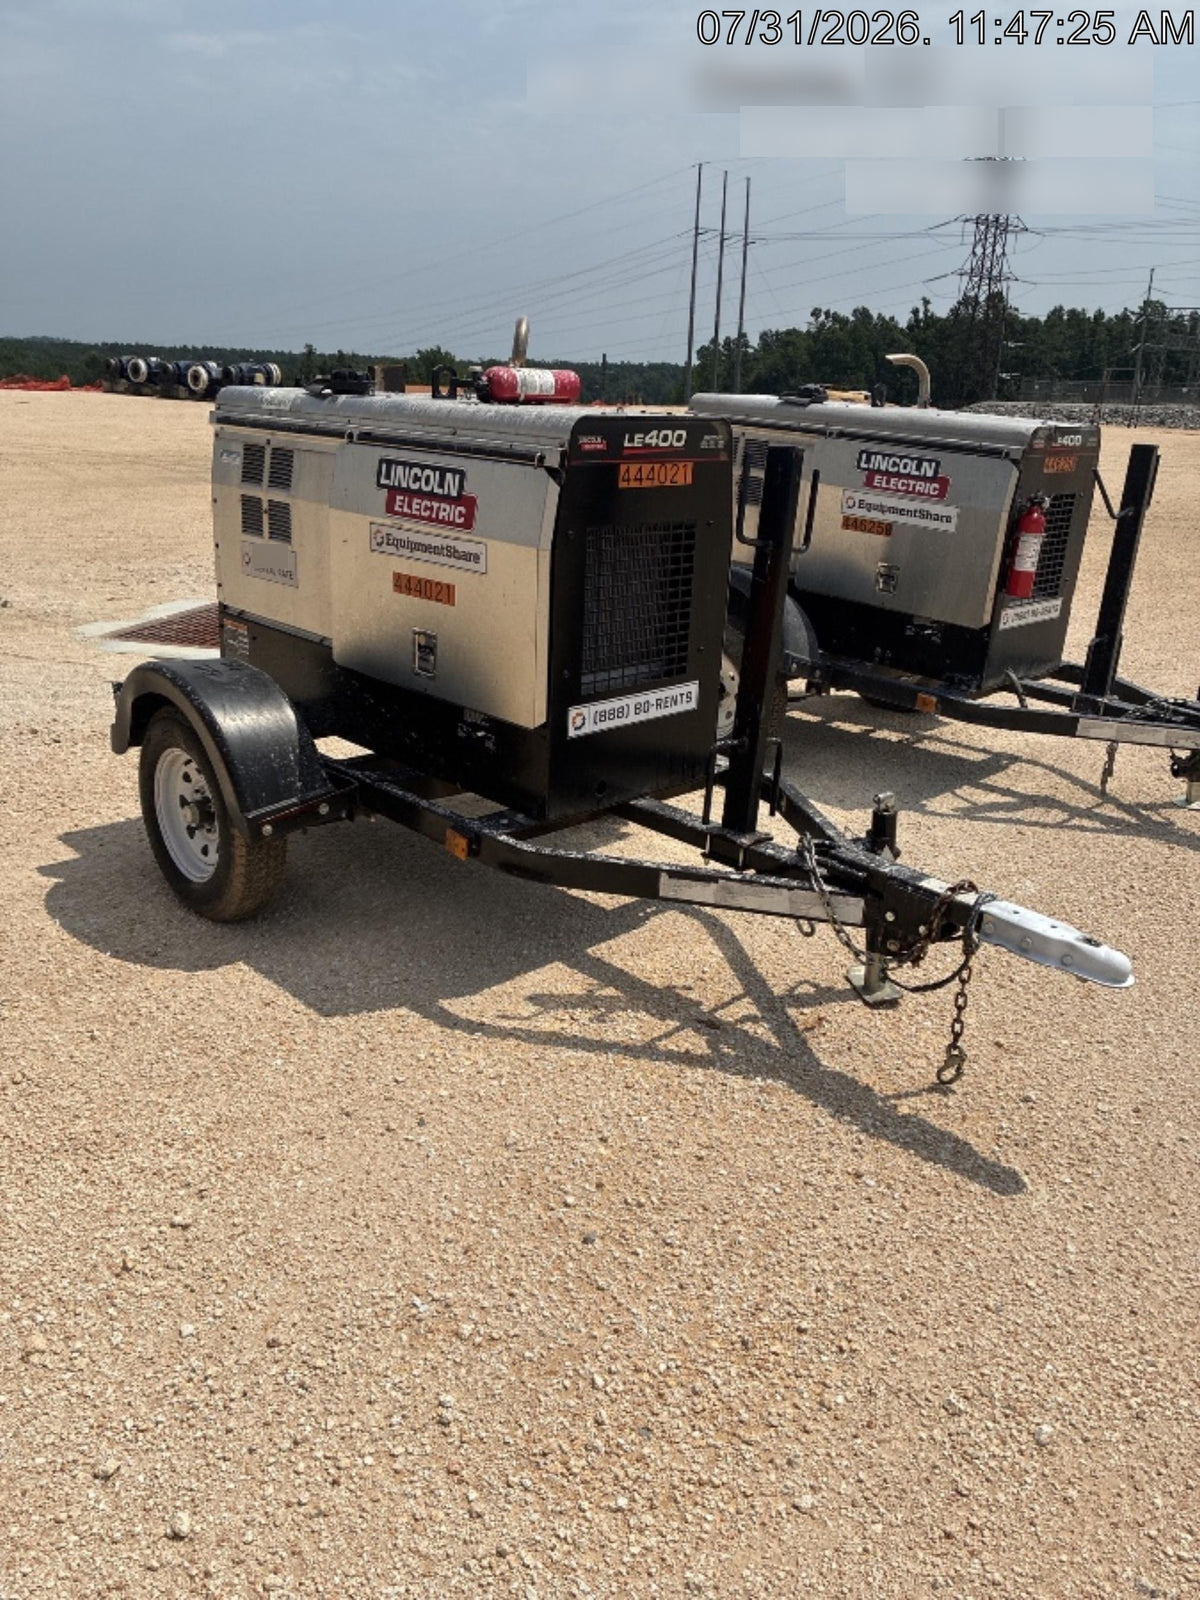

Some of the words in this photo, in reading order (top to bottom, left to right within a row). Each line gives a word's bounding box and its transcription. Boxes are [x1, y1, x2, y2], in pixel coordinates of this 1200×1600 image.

[624, 430, 687, 448] LE400
[621, 463, 689, 486] 444021
[860, 453, 936, 478] LINCOLN
[380, 463, 460, 497] LINCOLN
[873, 475, 939, 495] ELECTRIC
[394, 495, 466, 524] ELECTRIC
[858, 499, 952, 524] EquipmentShare
[386, 532, 480, 565] EquipmentShare
[393, 573, 451, 604] 444021
[593, 704, 629, 725] (888)
